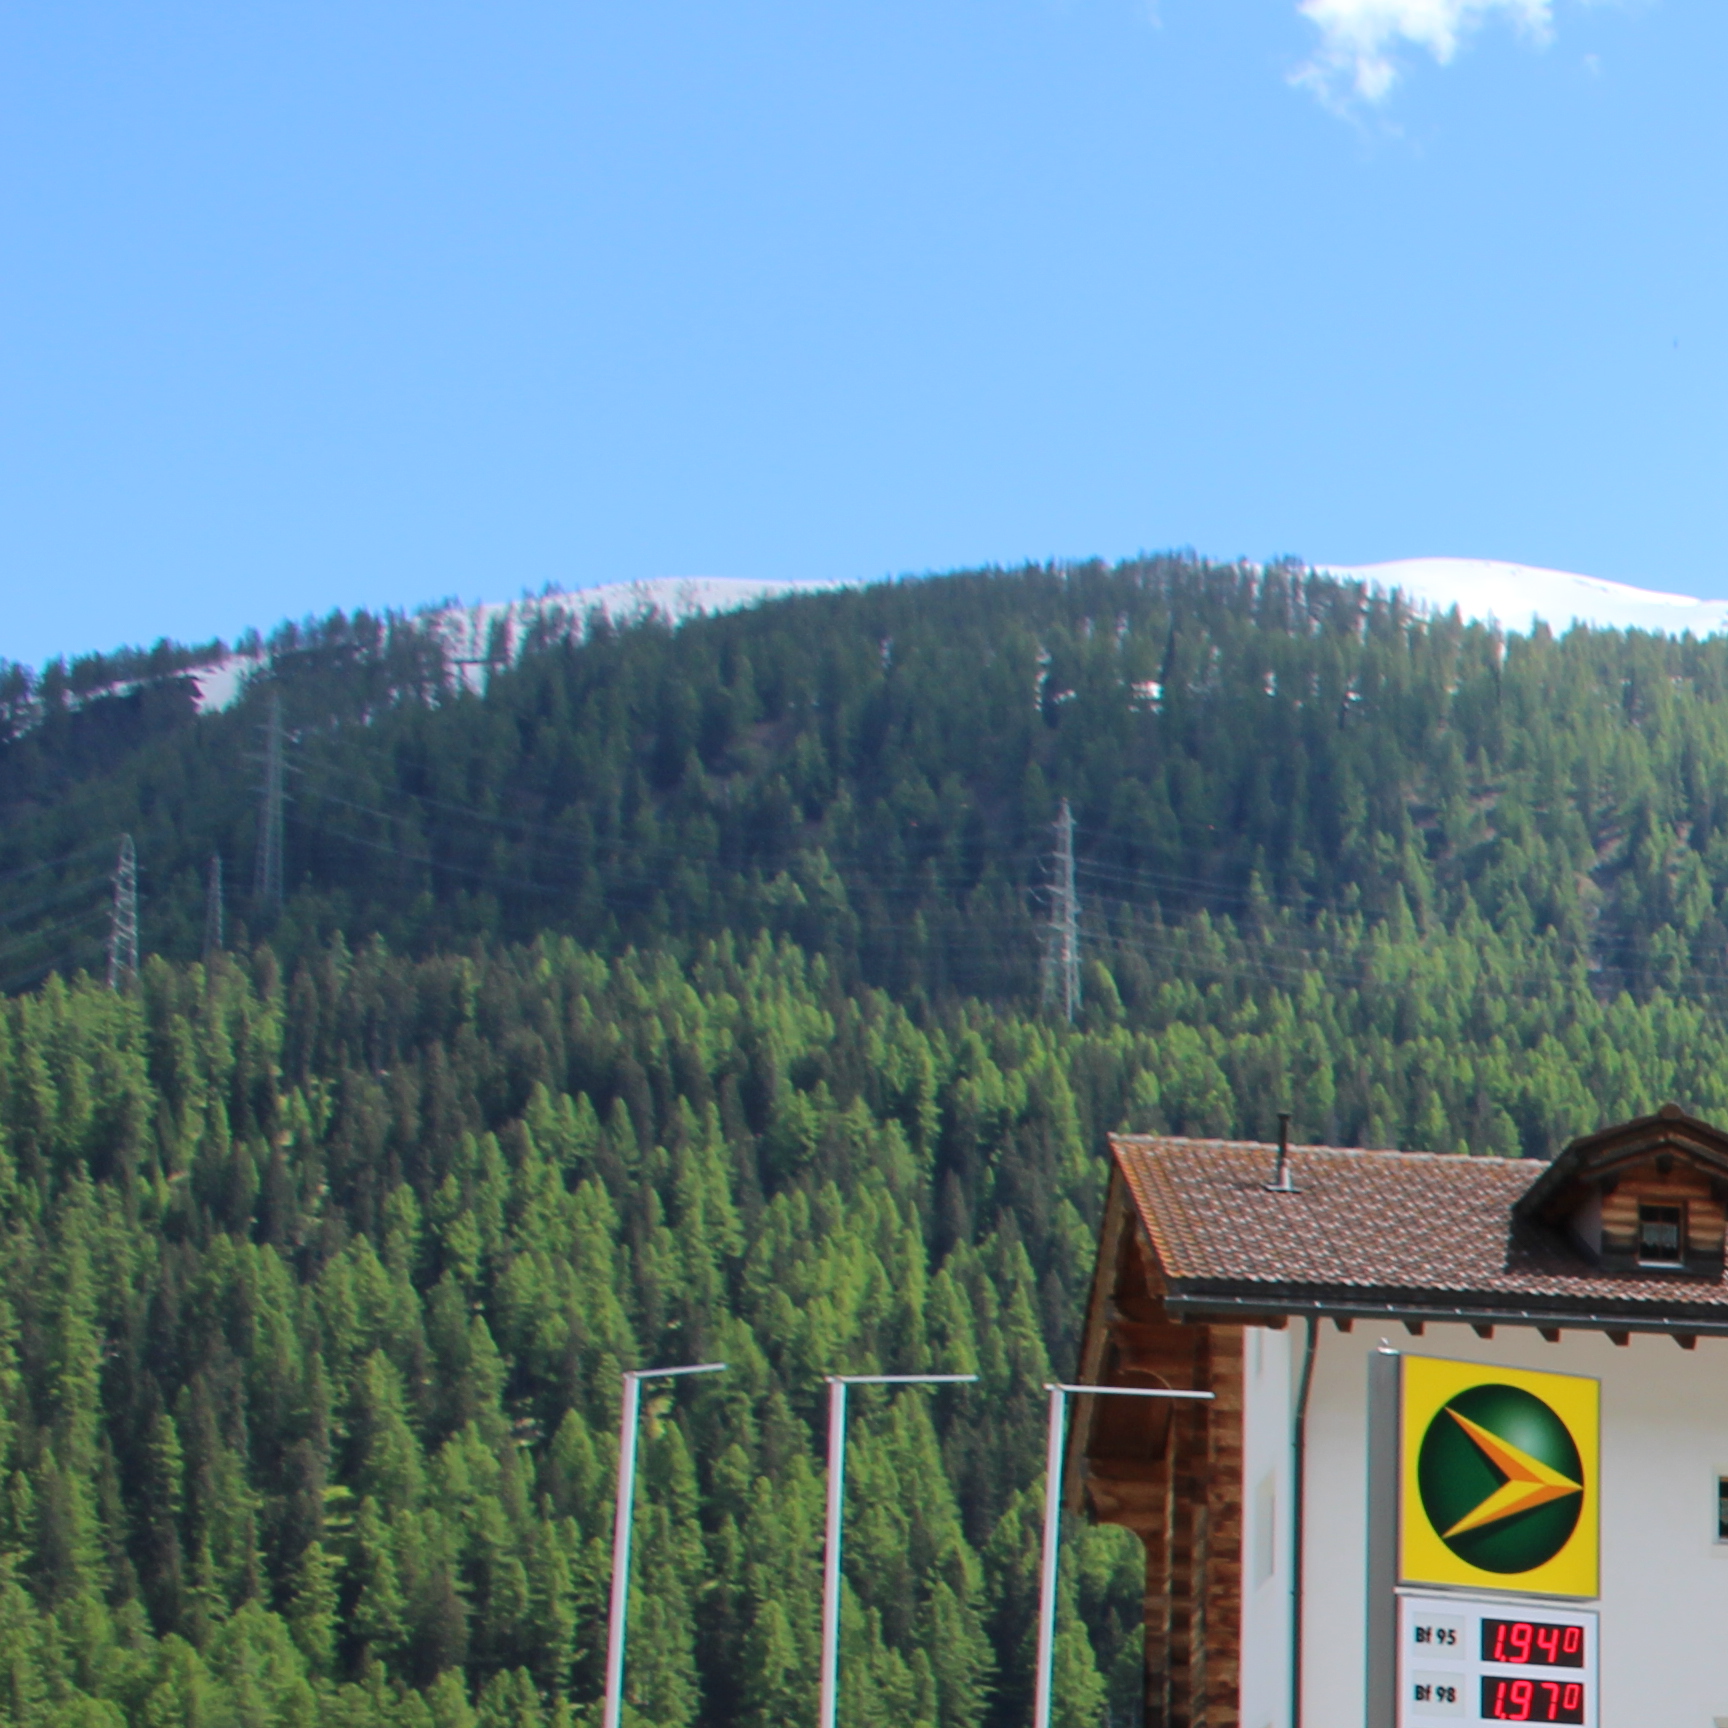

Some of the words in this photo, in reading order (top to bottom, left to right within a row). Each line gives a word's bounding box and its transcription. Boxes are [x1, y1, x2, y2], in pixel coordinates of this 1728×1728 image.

[1414, 1626, 1431, 1643] Bf
[1437, 1628, 1457, 1645] 95
[1414, 1684, 1431, 1701] Bf
[1436, 1686, 1457, 1703] 98
